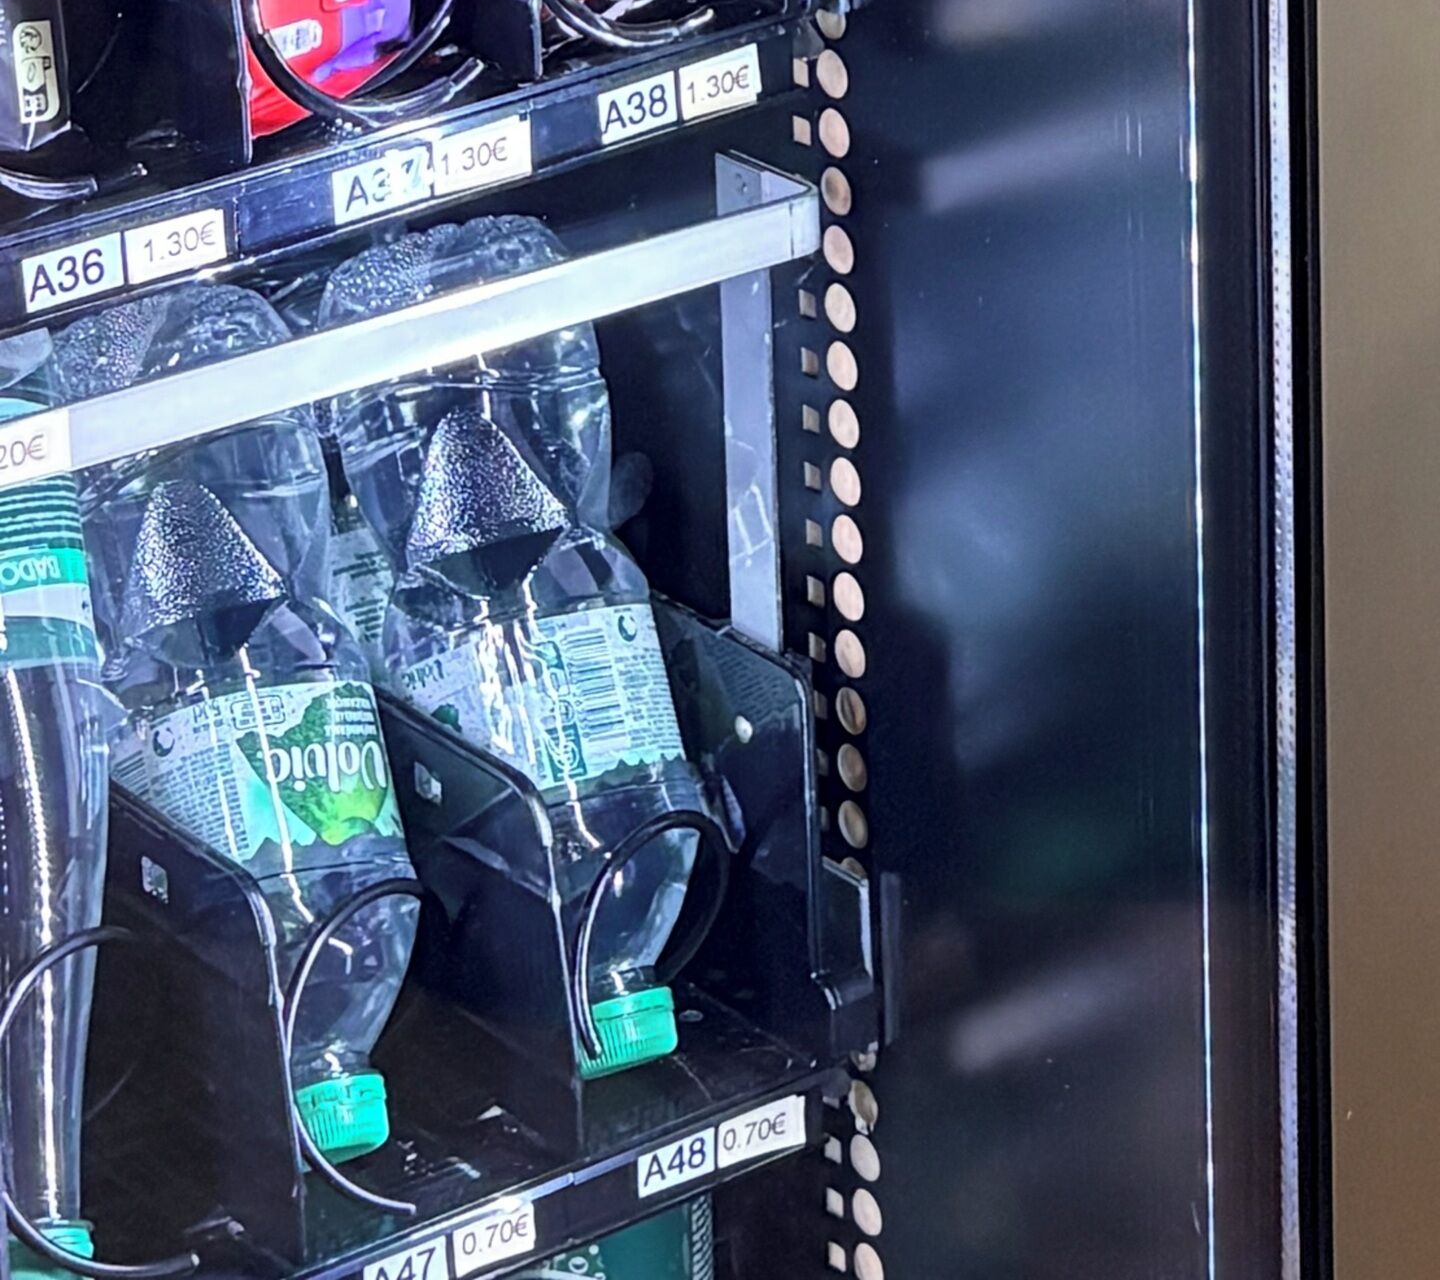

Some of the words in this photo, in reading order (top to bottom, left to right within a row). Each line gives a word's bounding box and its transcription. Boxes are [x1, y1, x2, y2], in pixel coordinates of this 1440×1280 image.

[602, 75, 669, 135] A38
[687, 63, 751, 108] 1.30€
[440, 135, 509, 178] 1.30€
[27, 248, 105, 305] A36
[143, 219, 217, 265] 1.30€
[257, 740, 388, 793] Volvic
[643, 1137, 706, 1187] A48
[723, 1111, 787, 1152] 0.70€
[462, 1212, 529, 1257] 0.70€
